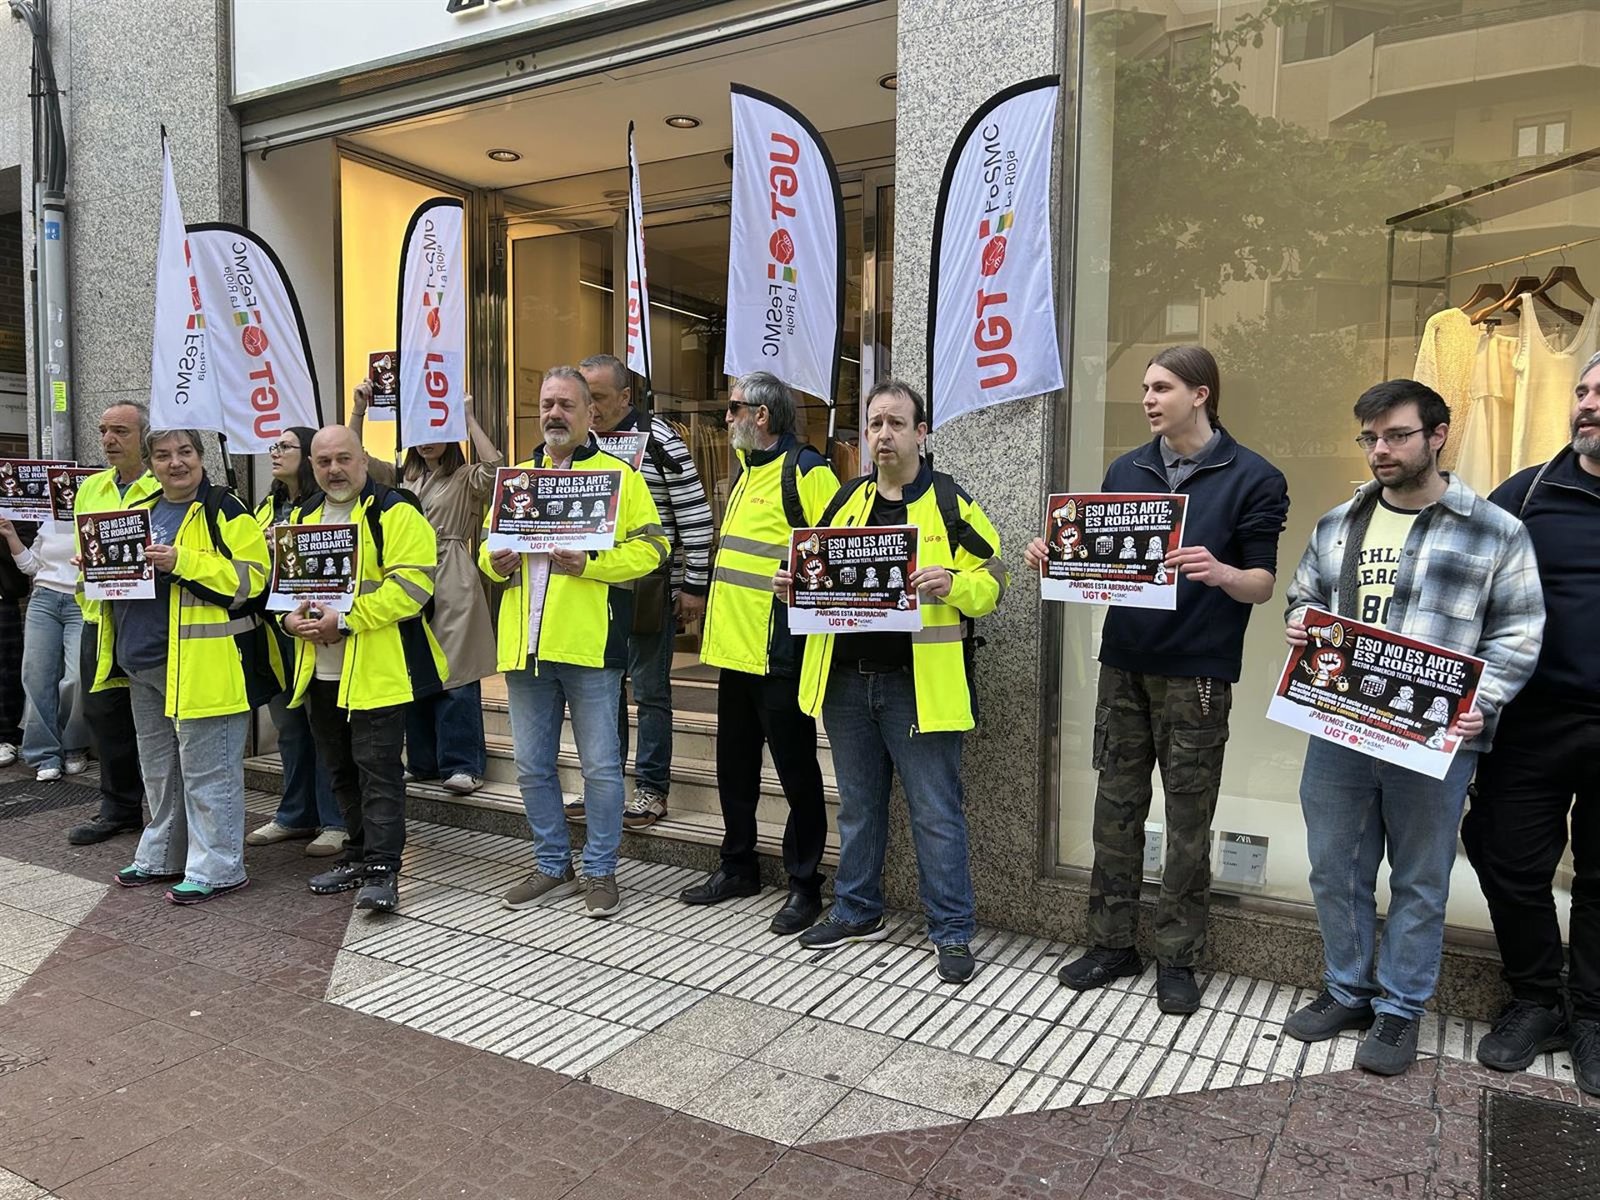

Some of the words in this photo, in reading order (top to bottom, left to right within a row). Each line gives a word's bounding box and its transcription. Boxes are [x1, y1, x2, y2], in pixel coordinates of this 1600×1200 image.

[1004, 150, 1019, 186] Rioja
[974, 288, 1017, 390] UGT
[424, 352, 449, 426] UGT
[539, 477, 556, 486] ESO
[558, 477, 570, 486] NO
[572, 476, 584, 486] ES
[586, 475, 611, 485] ARTE,
[556, 484, 611, 494] ROBARTE.
[1086, 504, 1104, 517] ESO
[1107, 503, 1120, 516] NO
[1123, 503, 1137, 514] ES
[1139, 501, 1172, 515] ARTE,
[99, 521, 110, 530] ESO
[111, 519, 118, 529] NO
[119, 517, 126, 527] ES
[126, 515, 144, 525] ARTE,
[1085, 517, 1101, 527] ES
[1104, 514, 1172, 526] ROBARTE.
[100, 530, 110, 539] ES
[111, 525, 145, 537] ROBARTE.
[297, 534, 310, 543] ESO
[311, 532, 321, 542] NO
[322, 531, 332, 540] ES
[334, 529, 352, 539] ARTE,
[310, 539, 353, 550] ROBARTE.
[828, 538, 846, 549] ESO
[848, 536, 860, 548] NO
[863, 536, 876, 547] ES
[878, 534, 907, 546] ARTE,
[828, 550, 844, 559] ES
[847, 546, 908, 558] ROBARTE.
[1359, 548, 1403, 566] THL
[1357, 568, 1397, 588] EAG
[1082, 591, 1099, 599] UGT
[1356, 636, 1382, 654] ESO
[1384, 644, 1403, 659] NO
[1405, 648, 1424, 665] ES
[1426, 655, 1466, 678] ARTE,
[1353, 649, 1376, 664] ES
[1379, 656, 1464, 688] ROBARTE.
[1352, 660, 1370, 670] SECTOR
[1370, 664, 1396, 676] COMERCIO
[1395, 671, 1412, 681] TEXTIL
[1436, 683, 1462, 696] NACIONAL
[1309, 710, 1344, 727] ¡PAREMOS
[1345, 723, 1361, 733] ESTA
[1362, 729, 1409, 750] ABERRACIÓN!
[1324, 726, 1349, 740] UGT
[1364, 739, 1385, 750] FeSMC
